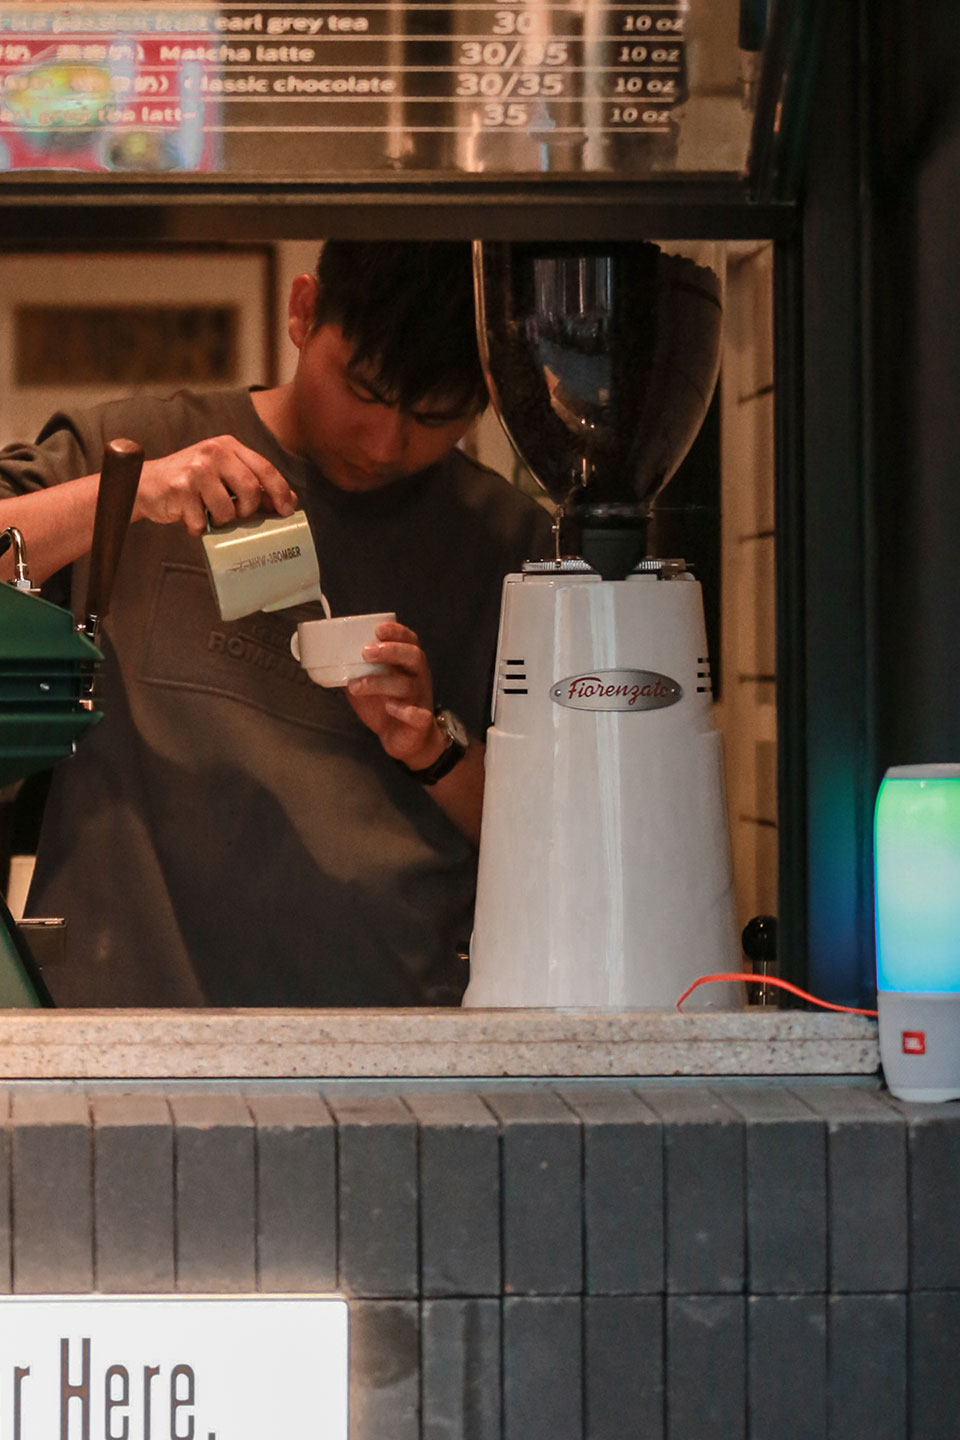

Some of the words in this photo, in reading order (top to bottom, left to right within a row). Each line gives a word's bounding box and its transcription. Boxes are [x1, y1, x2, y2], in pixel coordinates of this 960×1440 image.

[214, 13, 262, 32] earl
[267, 16, 323, 35] grey
[328, 14, 368, 32] tea
[492, 11, 539, 35] 30
[623, 15, 652, 31] 10
[656, 17, 684, 31] oz
[160, 45, 251, 62] Matcha
[256, 45, 315, 62] latte
[458, 42, 568, 69] 30/35
[619, 46, 647, 62] 10
[651, 48, 680, 62] oz
[273, 75, 396, 93] chocolate
[456, 72, 564, 98] 30/35
[614, 77, 642, 93] 10
[646, 79, 675, 93] oz
[484, 103, 528, 126] 35
[610, 107, 638, 123] 10
[641, 110, 670, 123] oz
[568, 676, 668, 706] Fiorenzato
[60, 1338, 217, 1440] Here.
